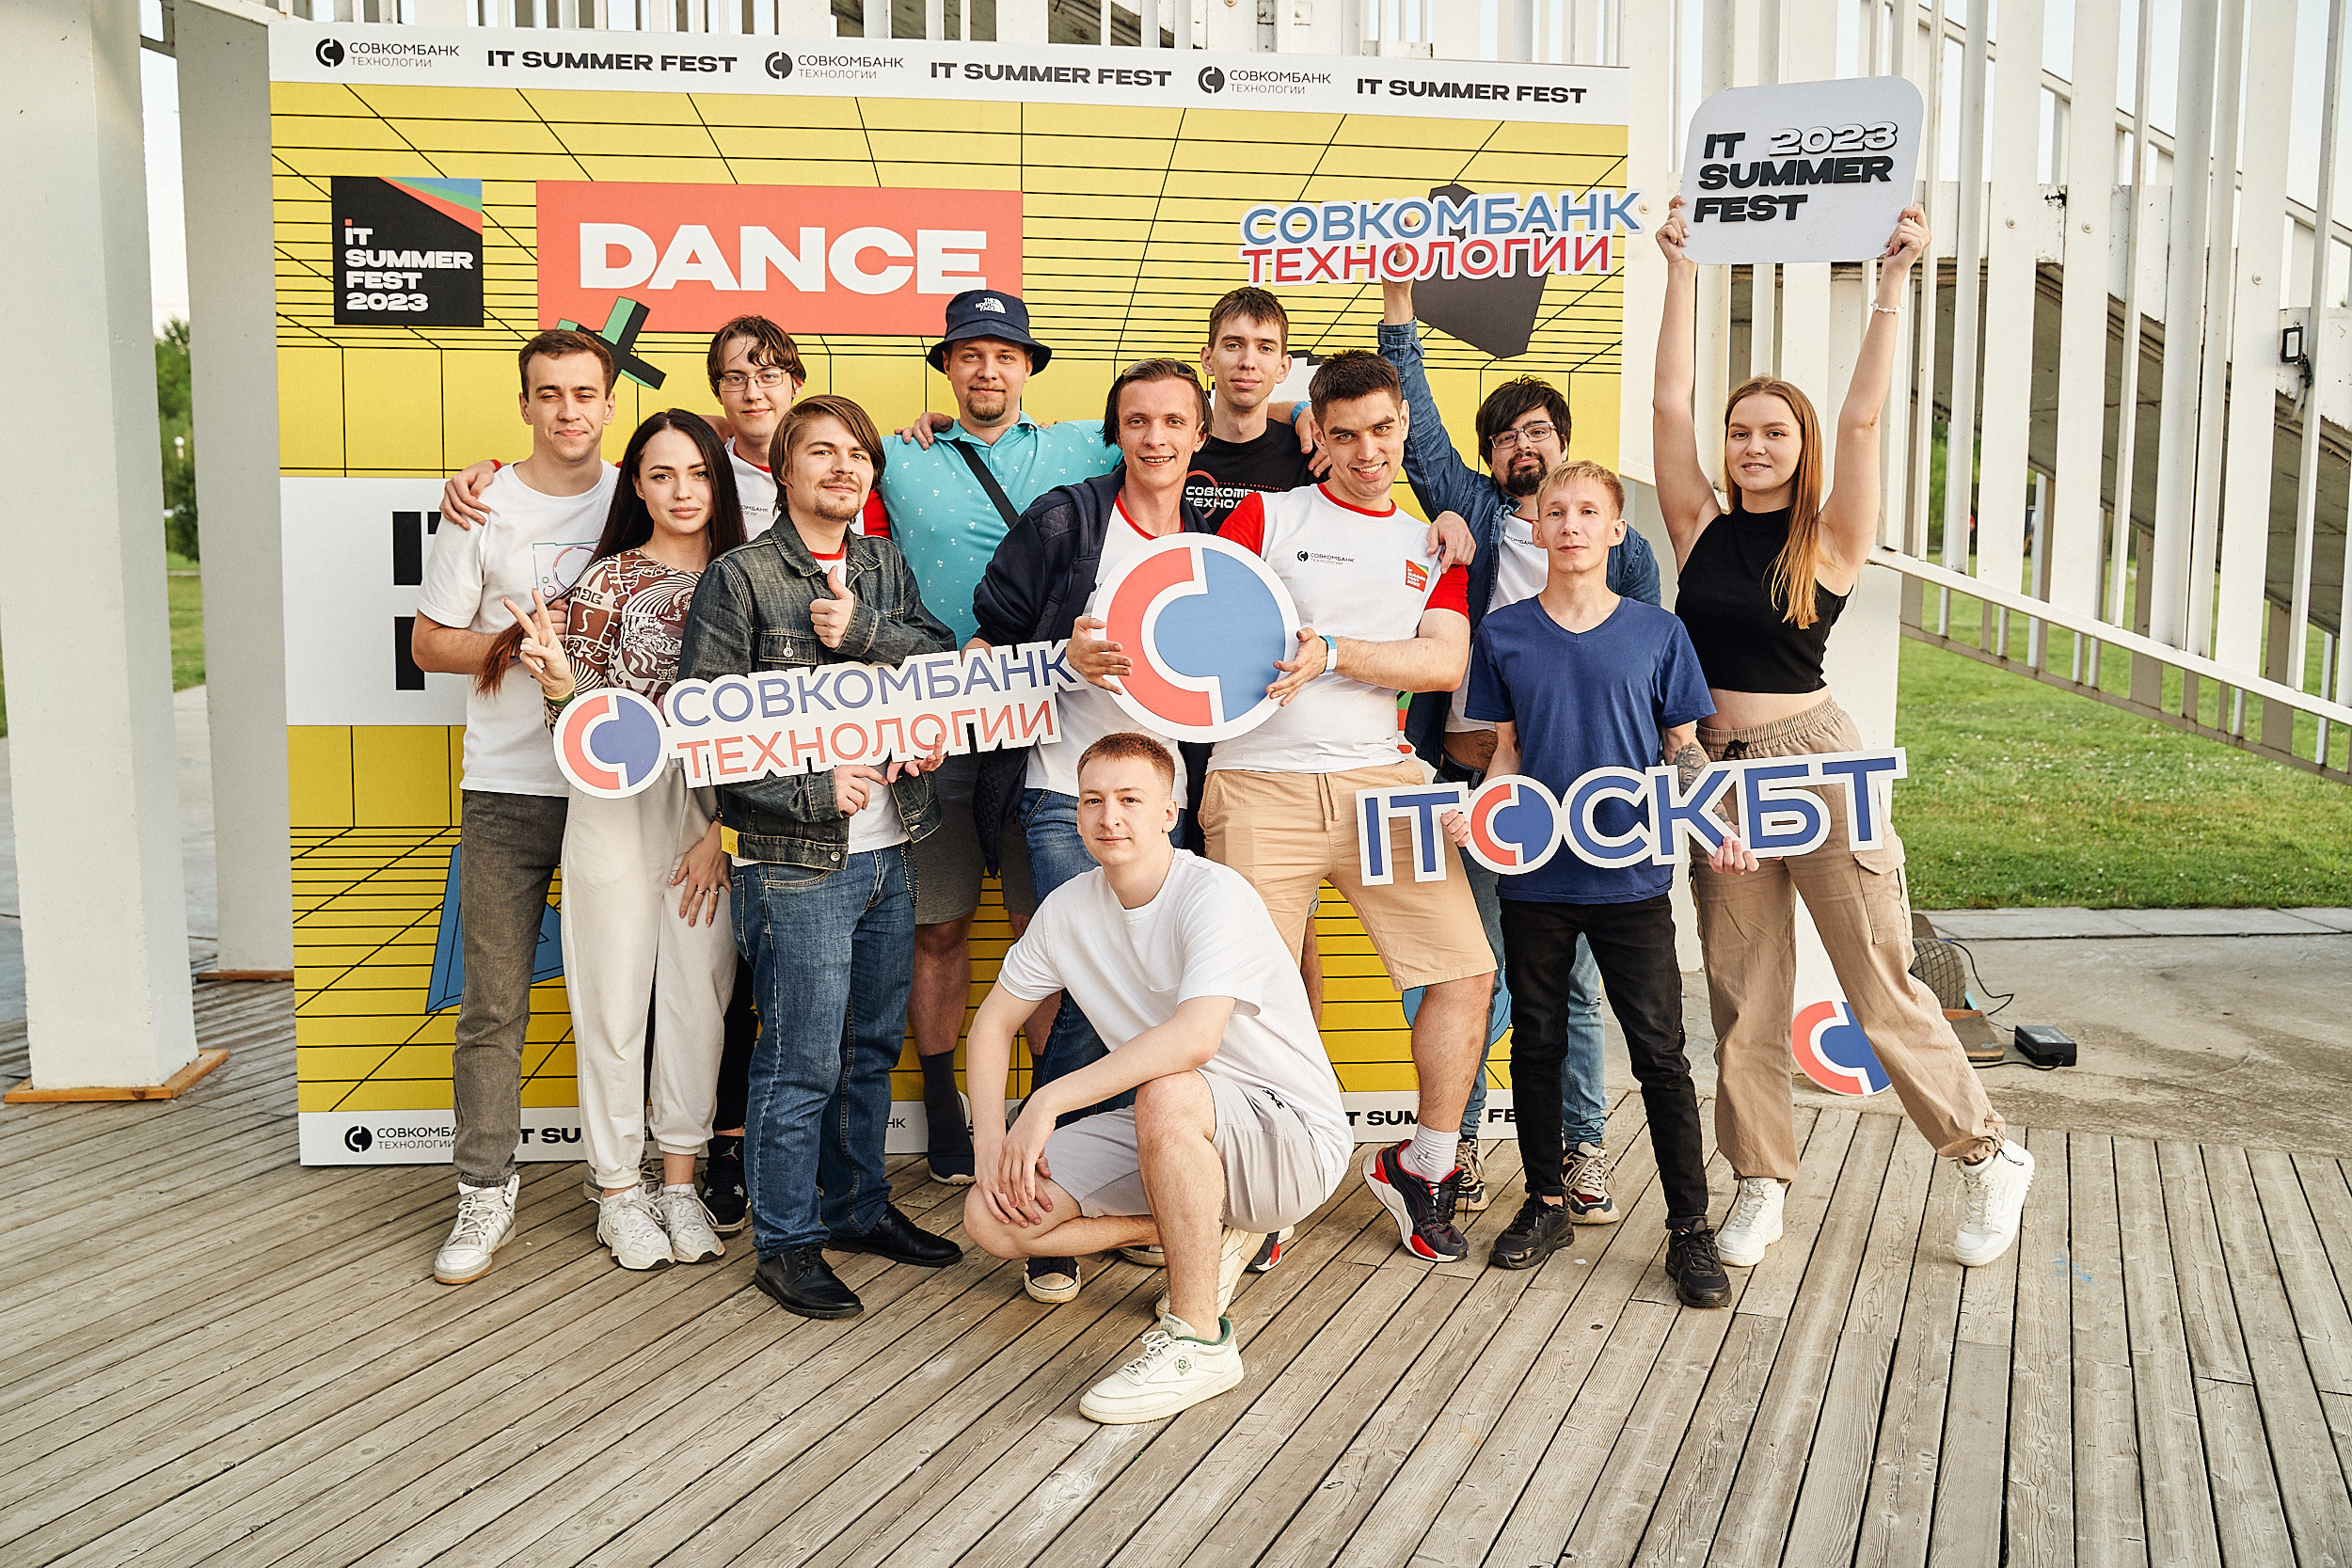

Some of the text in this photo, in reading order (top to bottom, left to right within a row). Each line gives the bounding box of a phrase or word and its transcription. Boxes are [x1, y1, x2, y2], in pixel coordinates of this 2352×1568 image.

[349, 41, 460, 56] СОВКОМБАНК
[350, 56, 432, 68] ТЕХНОЛОГИИ
[487, 50, 738, 73] IT SUMMER FEST
[798, 55, 904, 69] СОВКОМБАНК
[798, 69, 877, 79] ТЕХНОЛОГИИ
[930, 62, 1172, 87] IT SUMMER FEST
[1229, 70, 1331, 85] СОВКОМБАНК
[1230, 84, 1305, 95] ТЕХНОЛОГИИ
[1357, 78, 1587, 104] IT SUMMER FEST
[1703, 121, 1899, 159] IT 2023
[1697, 155, 1894, 190] SUMMER
[1244, 191, 1641, 245] СОВКОМБАНК
[1692, 194, 1809, 223] FEST
[344, 248, 474, 270] SUMMER
[580, 222, 988, 295] DANCE
[1242, 235, 1610, 284] ТЕХНОЛОГИИ
[345, 270, 423, 290] FEST
[345, 292, 429, 312] 2023
[674, 647, 1078, 727] СОВКОМБАНК
[676, 700, 1055, 780] ТЕХНОЛОГИИ
